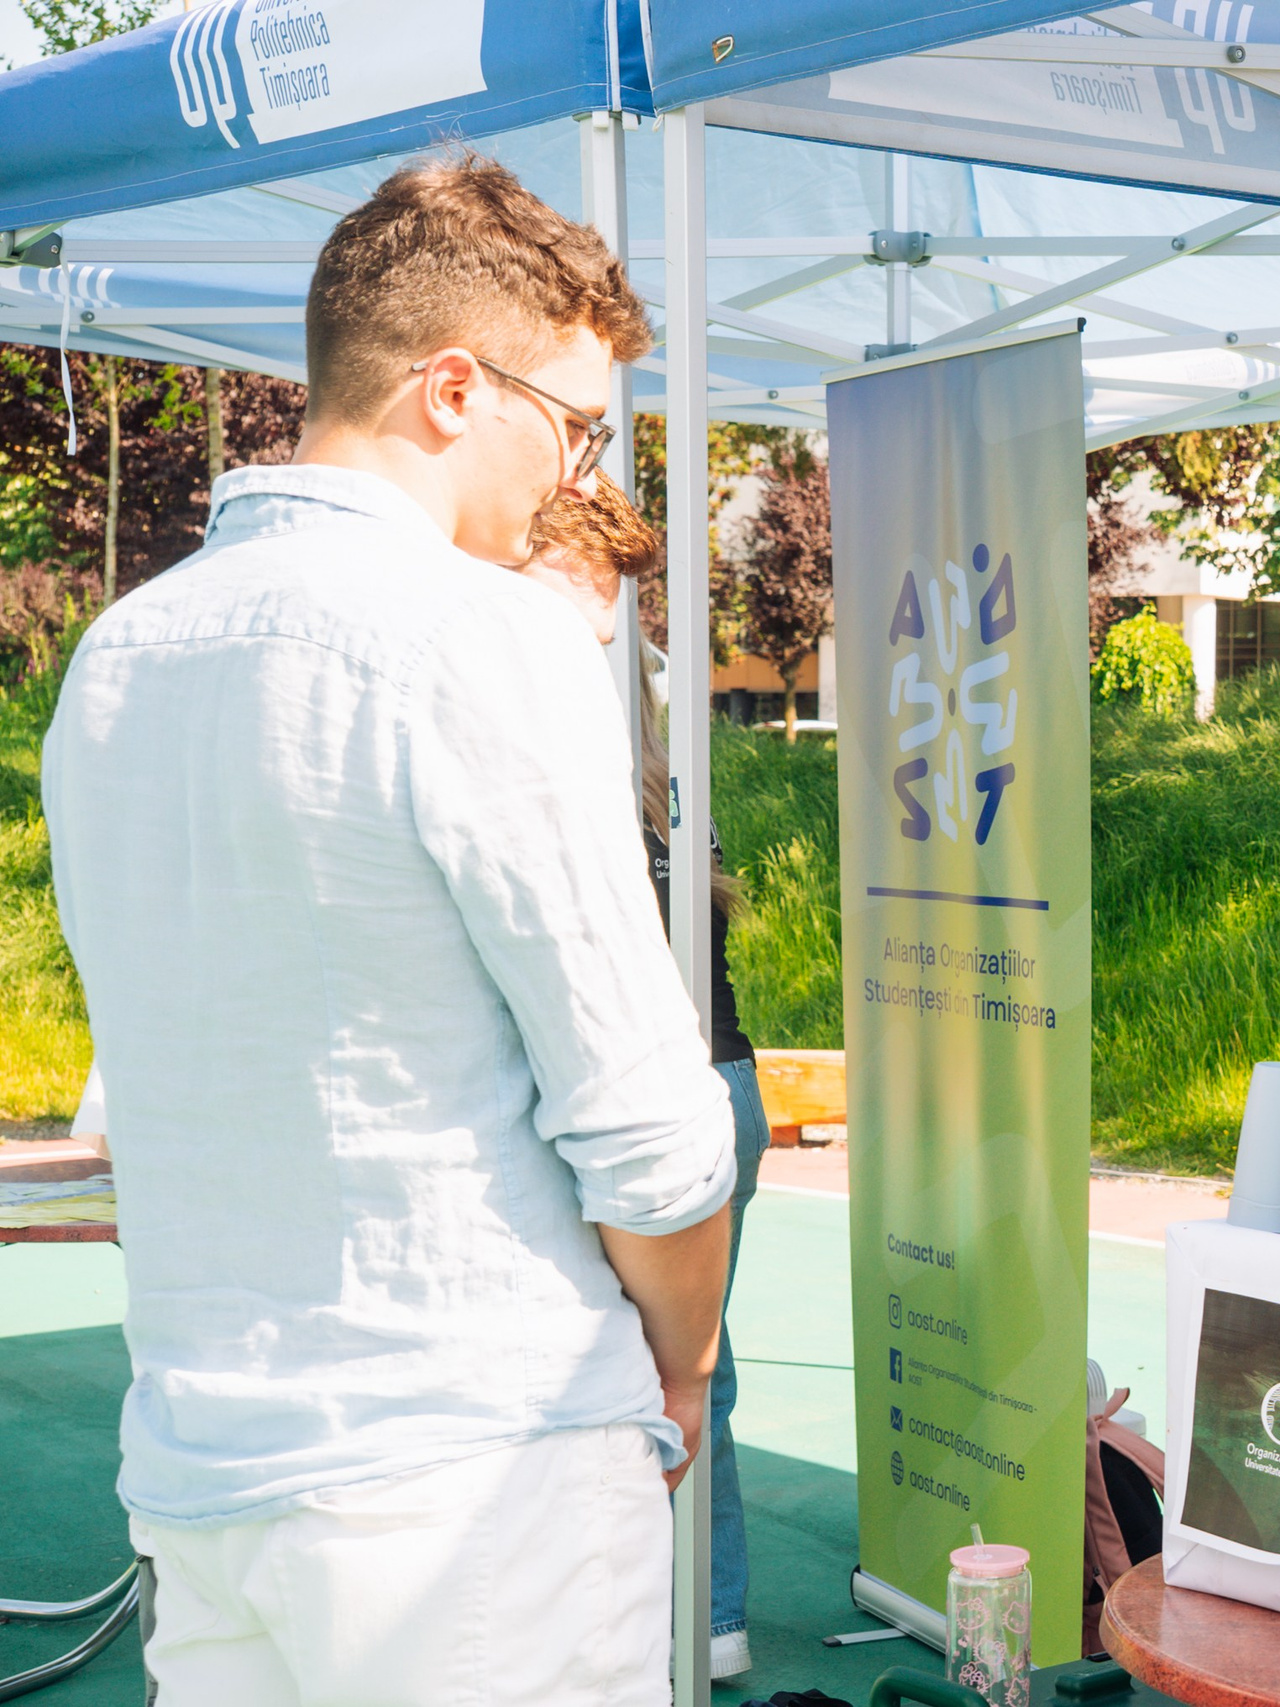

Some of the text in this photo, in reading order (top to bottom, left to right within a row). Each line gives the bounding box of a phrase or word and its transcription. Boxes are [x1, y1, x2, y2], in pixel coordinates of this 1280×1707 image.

[250, 5, 331, 61] Politehnica
[259, 62, 331, 111] Timișoara
[884, 937, 1036, 985] Alianța Organizațiilor
[864, 978, 1056, 1033] Studențești din Timișoara
[888, 1233, 955, 1271] Contact us!
[907, 1309, 968, 1345] aost.online
[909, 1416, 1026, 1482] contact@aost.online
[910, 1471, 971, 1512] aost.online
